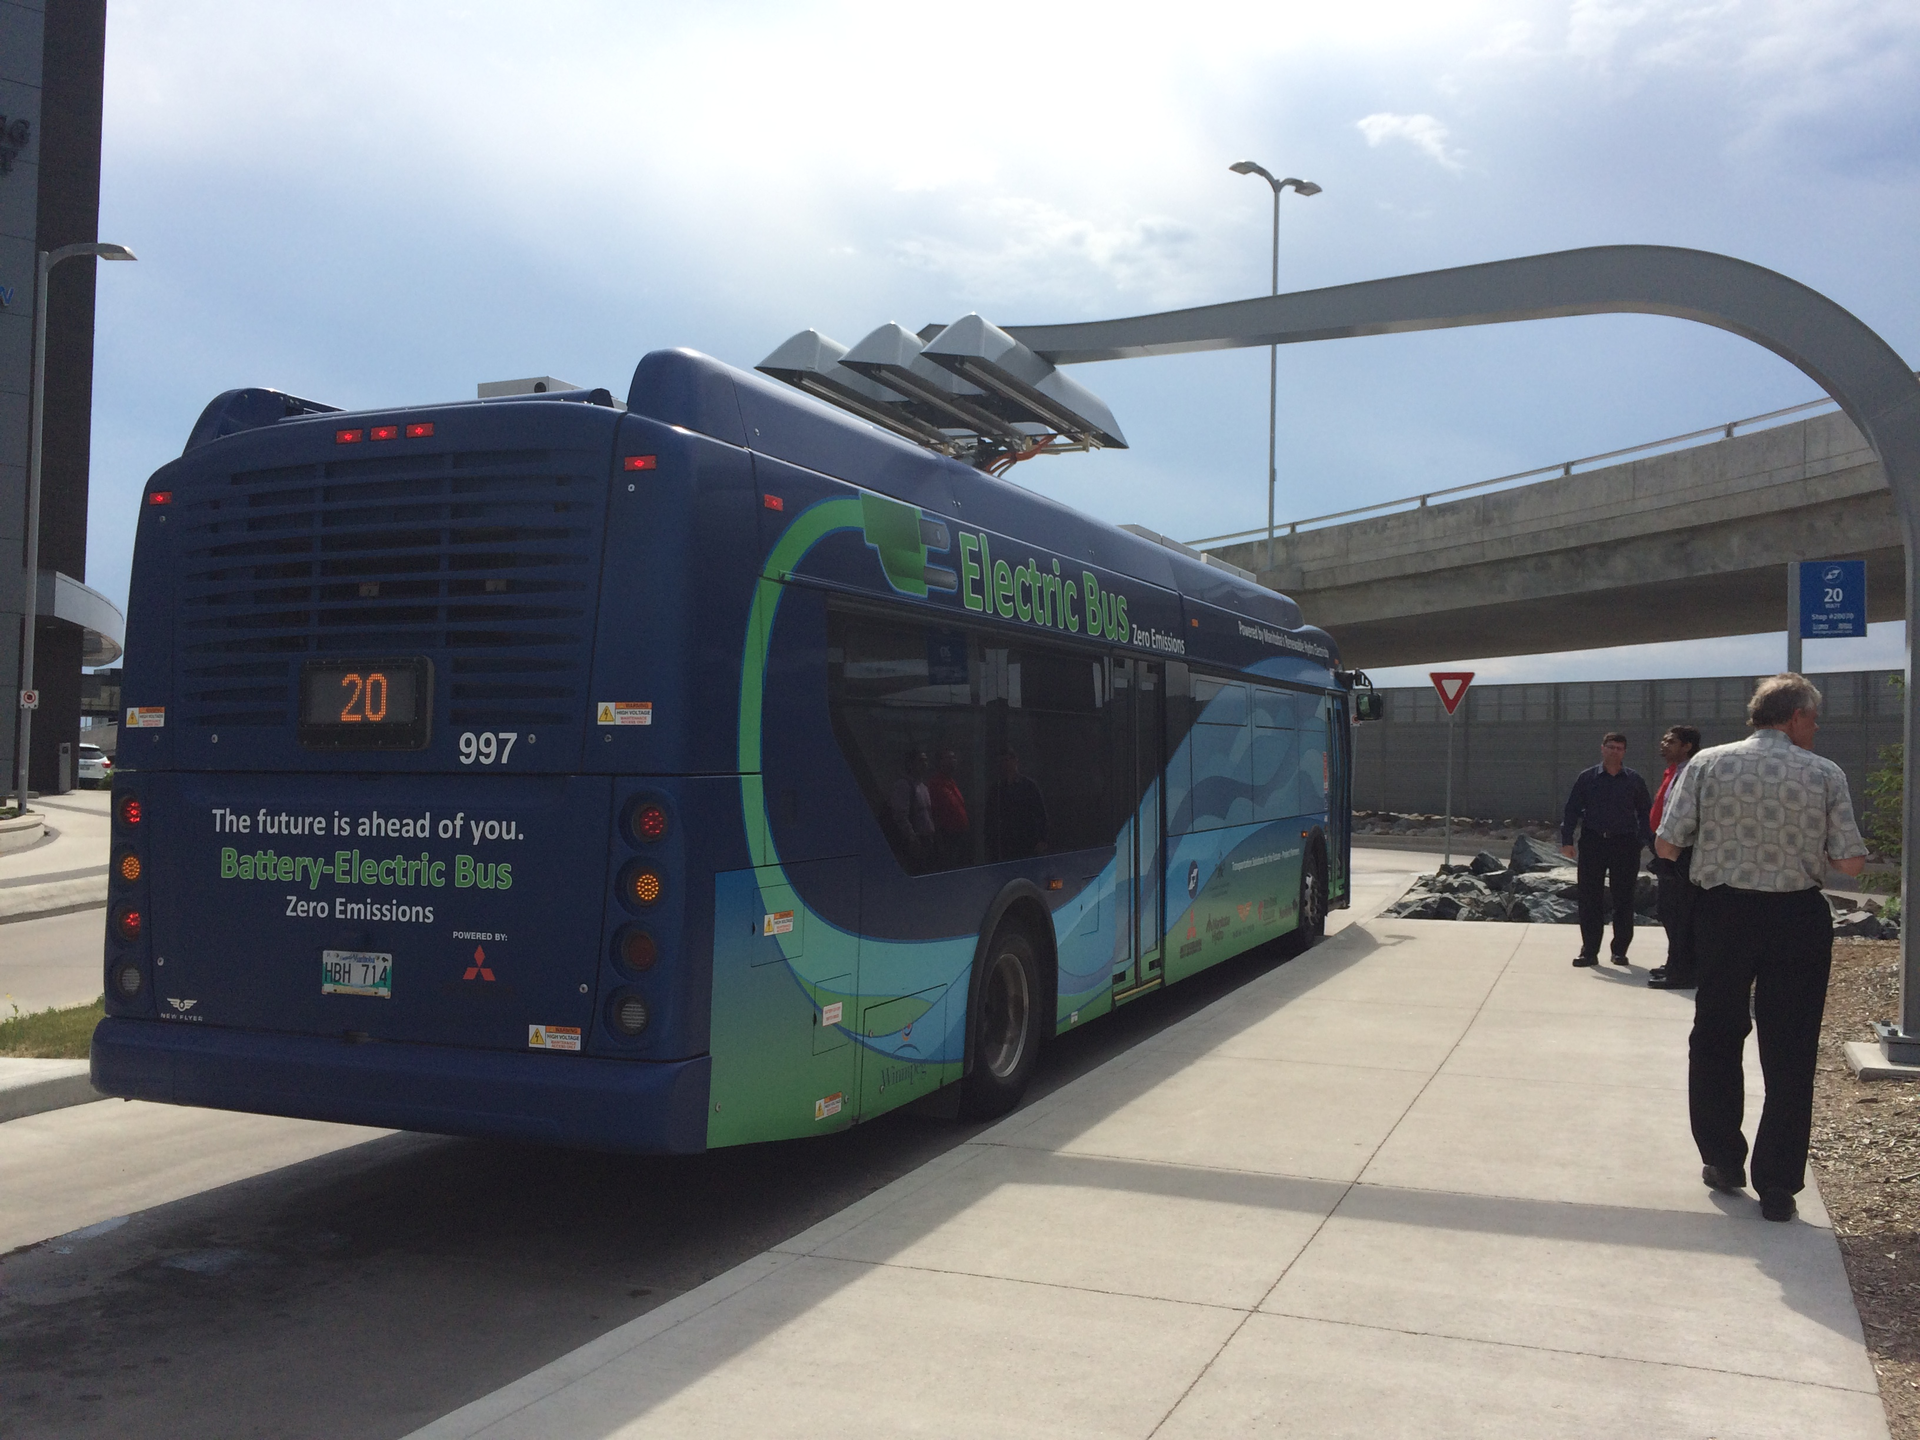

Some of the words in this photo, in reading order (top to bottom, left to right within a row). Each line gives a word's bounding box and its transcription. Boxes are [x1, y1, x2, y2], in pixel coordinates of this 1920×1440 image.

[958, 531, 1080, 633] Electric
[1082, 570, 1130, 644] Bus
[1824, 588, 1843, 602] 20
[1131, 623, 1150, 648] Zero
[1150, 628, 1186, 655] Emissions
[340, 673, 387, 722] 20
[459, 731, 518, 765] 997
[212, 808, 251, 833] The
[257, 809, 326, 835] future
[333, 811, 350, 836] is
[357, 812, 431, 838] ahead
[438, 813, 464, 839] of
[470, 816, 525, 845] you.
[220, 847, 446, 890] Battery-Electric
[455, 854, 513, 890] Bus
[286, 895, 329, 918] Zero
[335, 898, 435, 923] Emissions
[452, 931, 493, 940] POWERED
[494, 933, 508, 942] BY:
[324, 962, 351, 984] HBH
[361, 964, 388, 986] 714
[179, 1014, 203, 1022] FLYER
